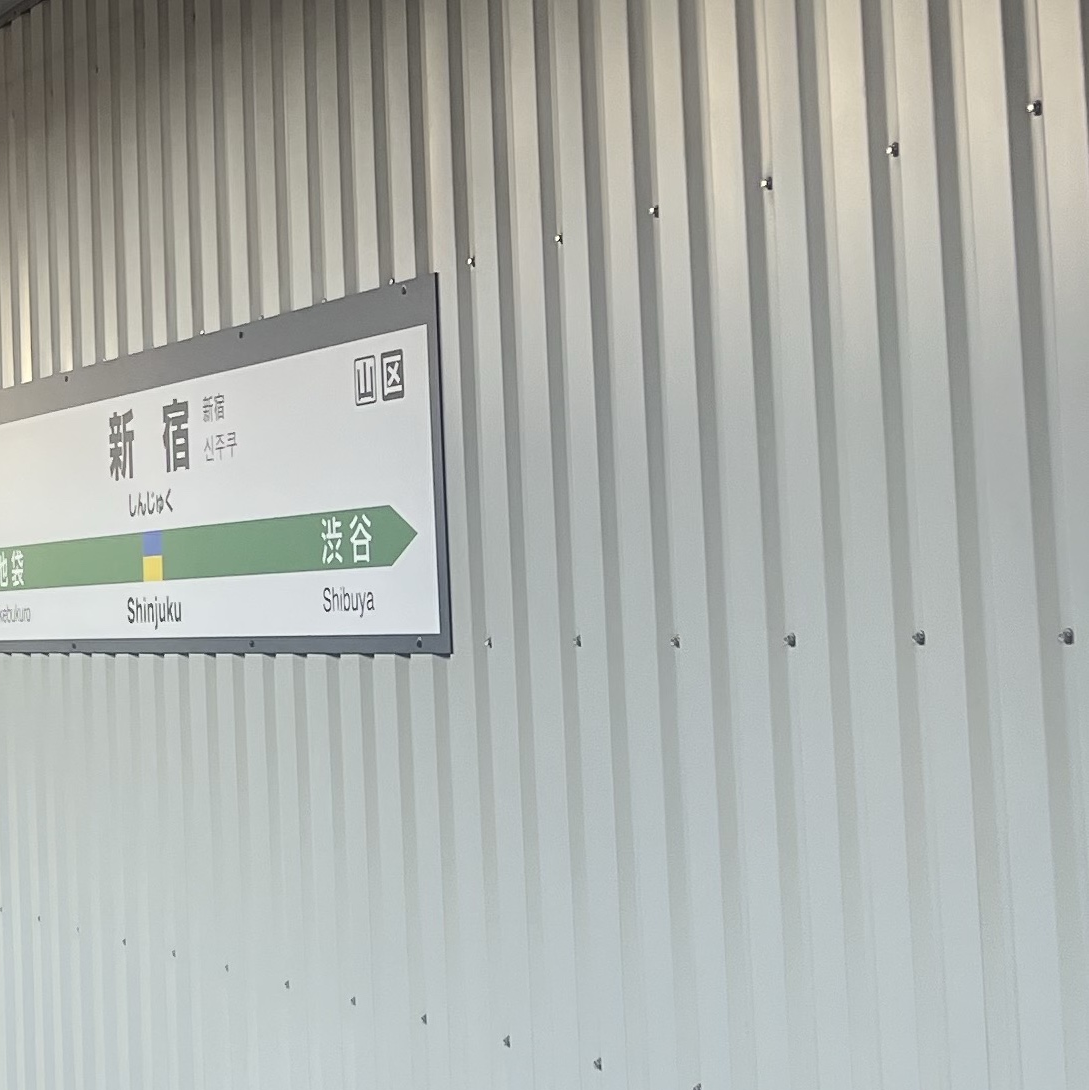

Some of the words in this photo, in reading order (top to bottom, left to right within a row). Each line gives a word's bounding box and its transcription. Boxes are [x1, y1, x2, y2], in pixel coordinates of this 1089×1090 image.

[109, 399, 190, 481] 新宿
[203, 432, 238, 461] 신주쿠
[129, 488, 173, 517] しんじゅく
[321, 513, 372, 564] 渋谷
[127, 596, 182, 630] Shinjuku
[322, 586, 375, 618] Shibuya
